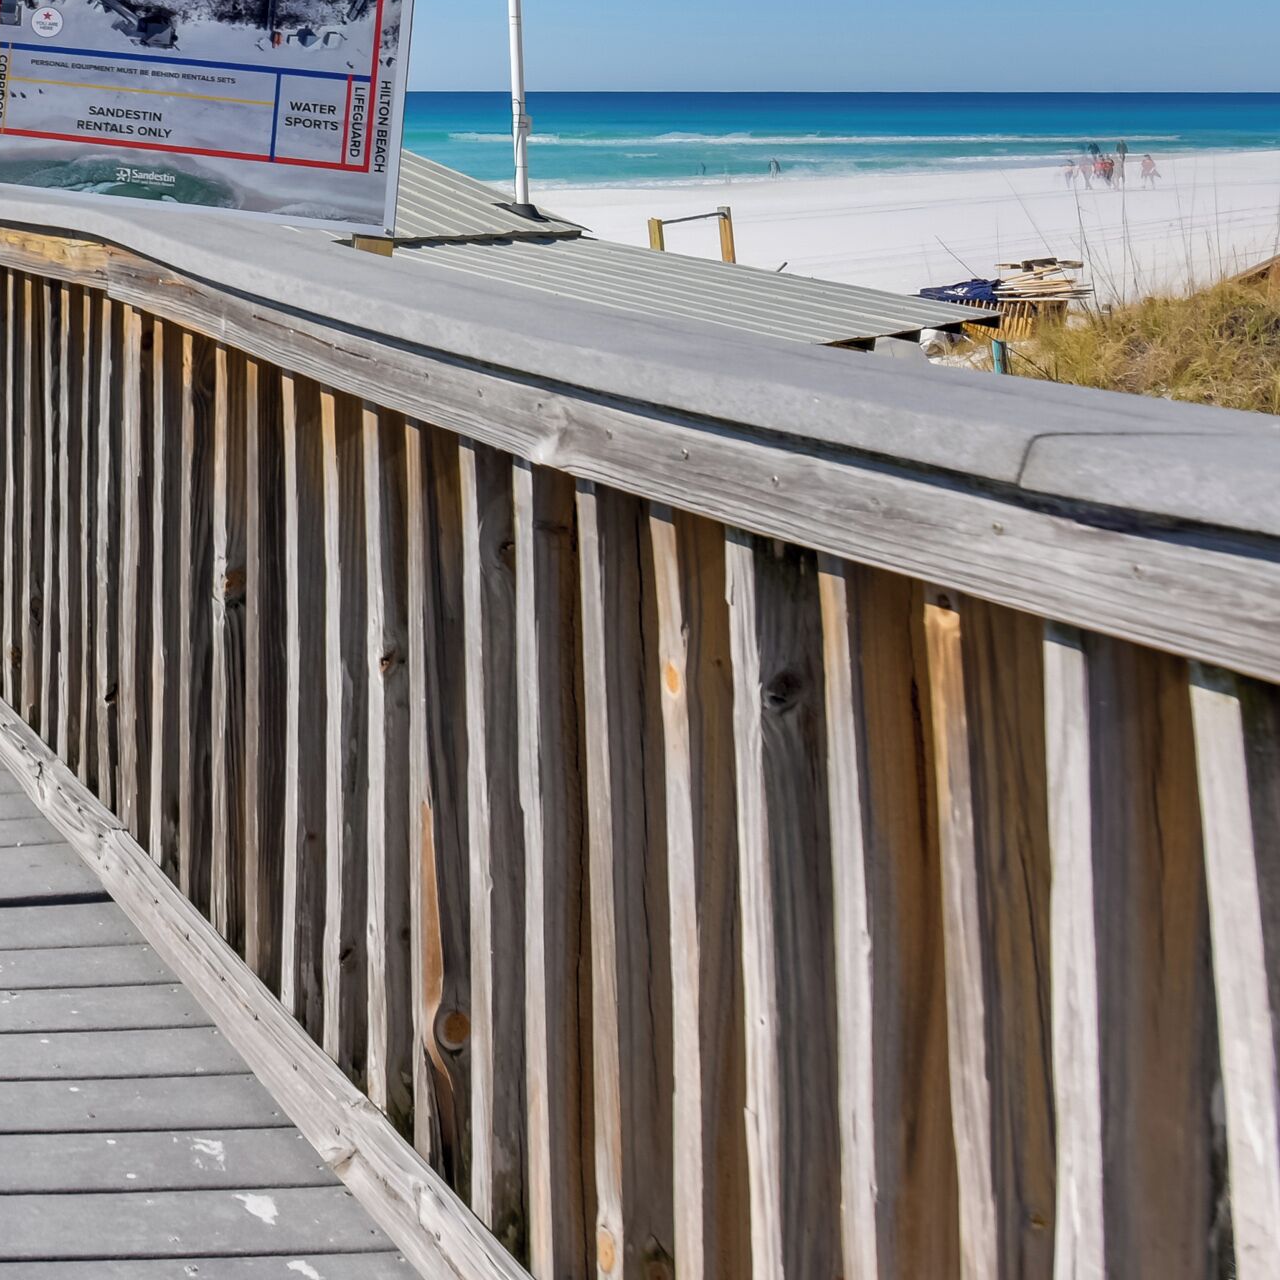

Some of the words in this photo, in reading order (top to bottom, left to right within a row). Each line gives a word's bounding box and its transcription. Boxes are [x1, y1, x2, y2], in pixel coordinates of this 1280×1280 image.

[31, 59, 69, 68] PERSONAL
[71, 63, 115, 73] EQUIPMENT
[117, 67, 137, 75] MUST
[151, 70, 180, 79] BEHIND
[181, 73, 215, 82] RENTALS
[217, 76, 236, 84] SETS
[290, 101, 336, 115] WATER
[377, 80, 392, 126] HILTON
[88, 106, 163, 121] SANDESTIN
[349, 87, 366, 158] LIFEGUARD
[77, 120, 134, 134] RENTALS
[137, 126, 173, 138] ONLY
[285, 117, 338, 131] SPORTS
[374, 129, 387, 173] BEACH
[132, 169, 175, 182] Sandestin
